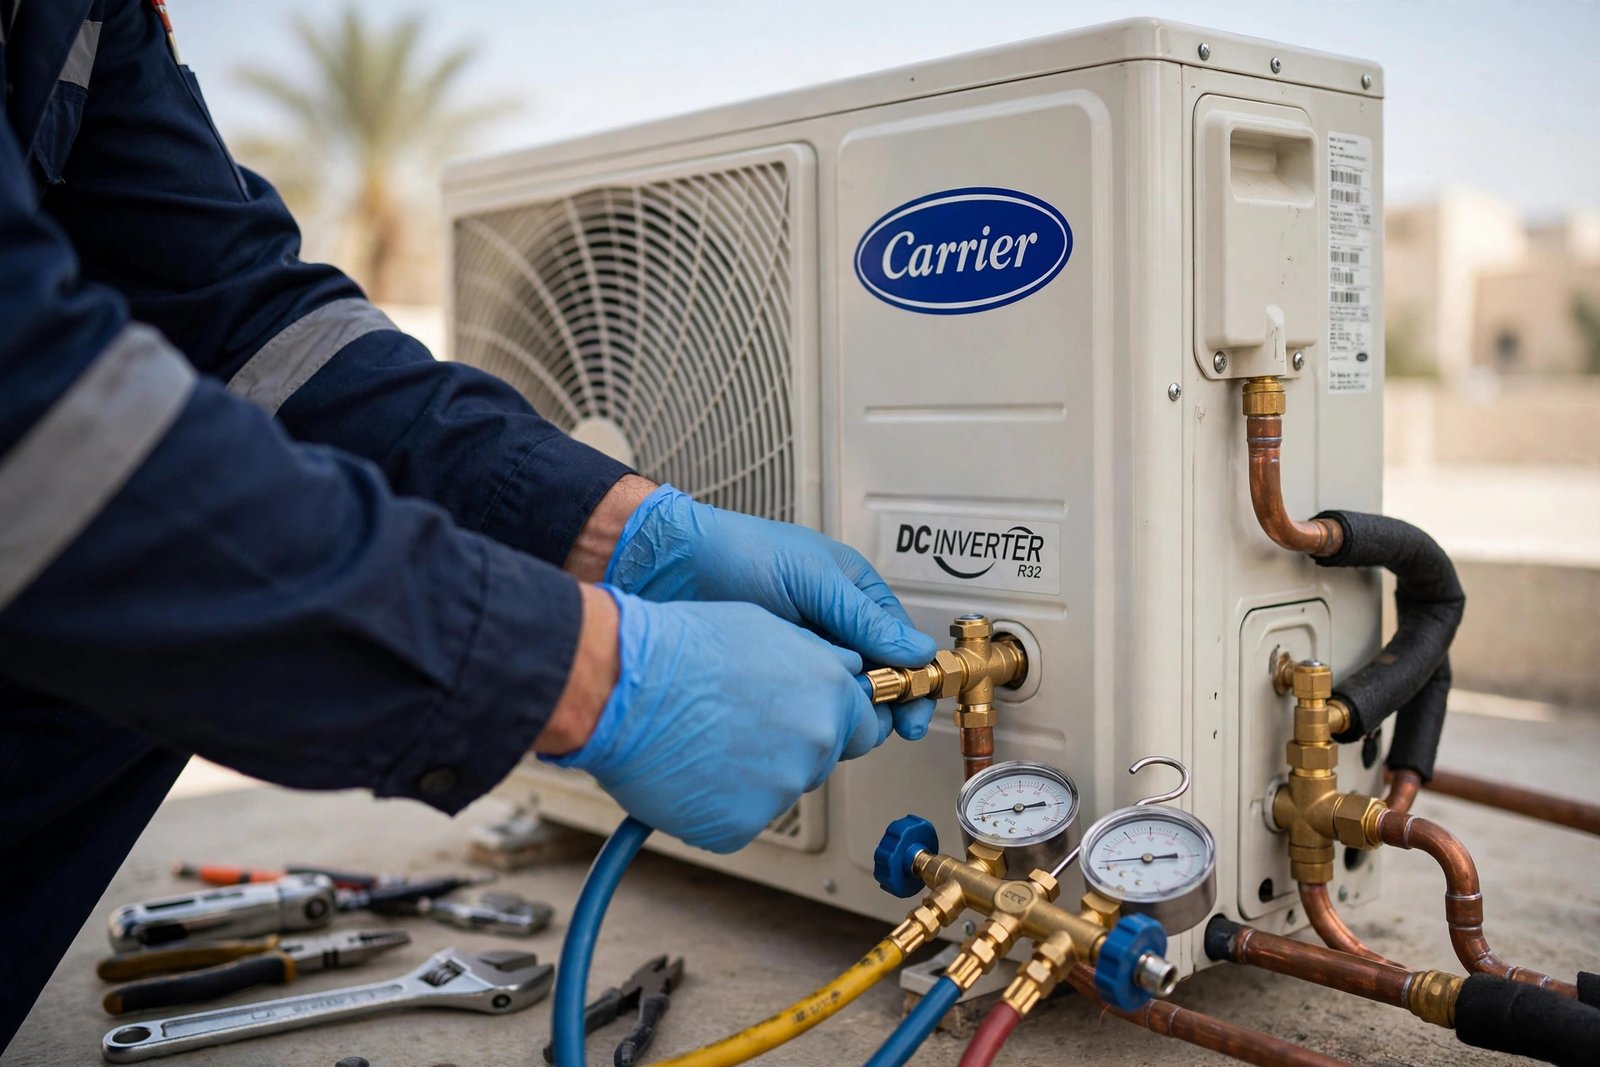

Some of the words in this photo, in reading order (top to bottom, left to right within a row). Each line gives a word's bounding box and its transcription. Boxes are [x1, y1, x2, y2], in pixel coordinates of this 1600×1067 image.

[882, 225, 1038, 280] Carrier
[896, 524, 932, 554] DC
[933, 528, 1044, 562] INVERTER
[1017, 564, 1042, 579] R32
